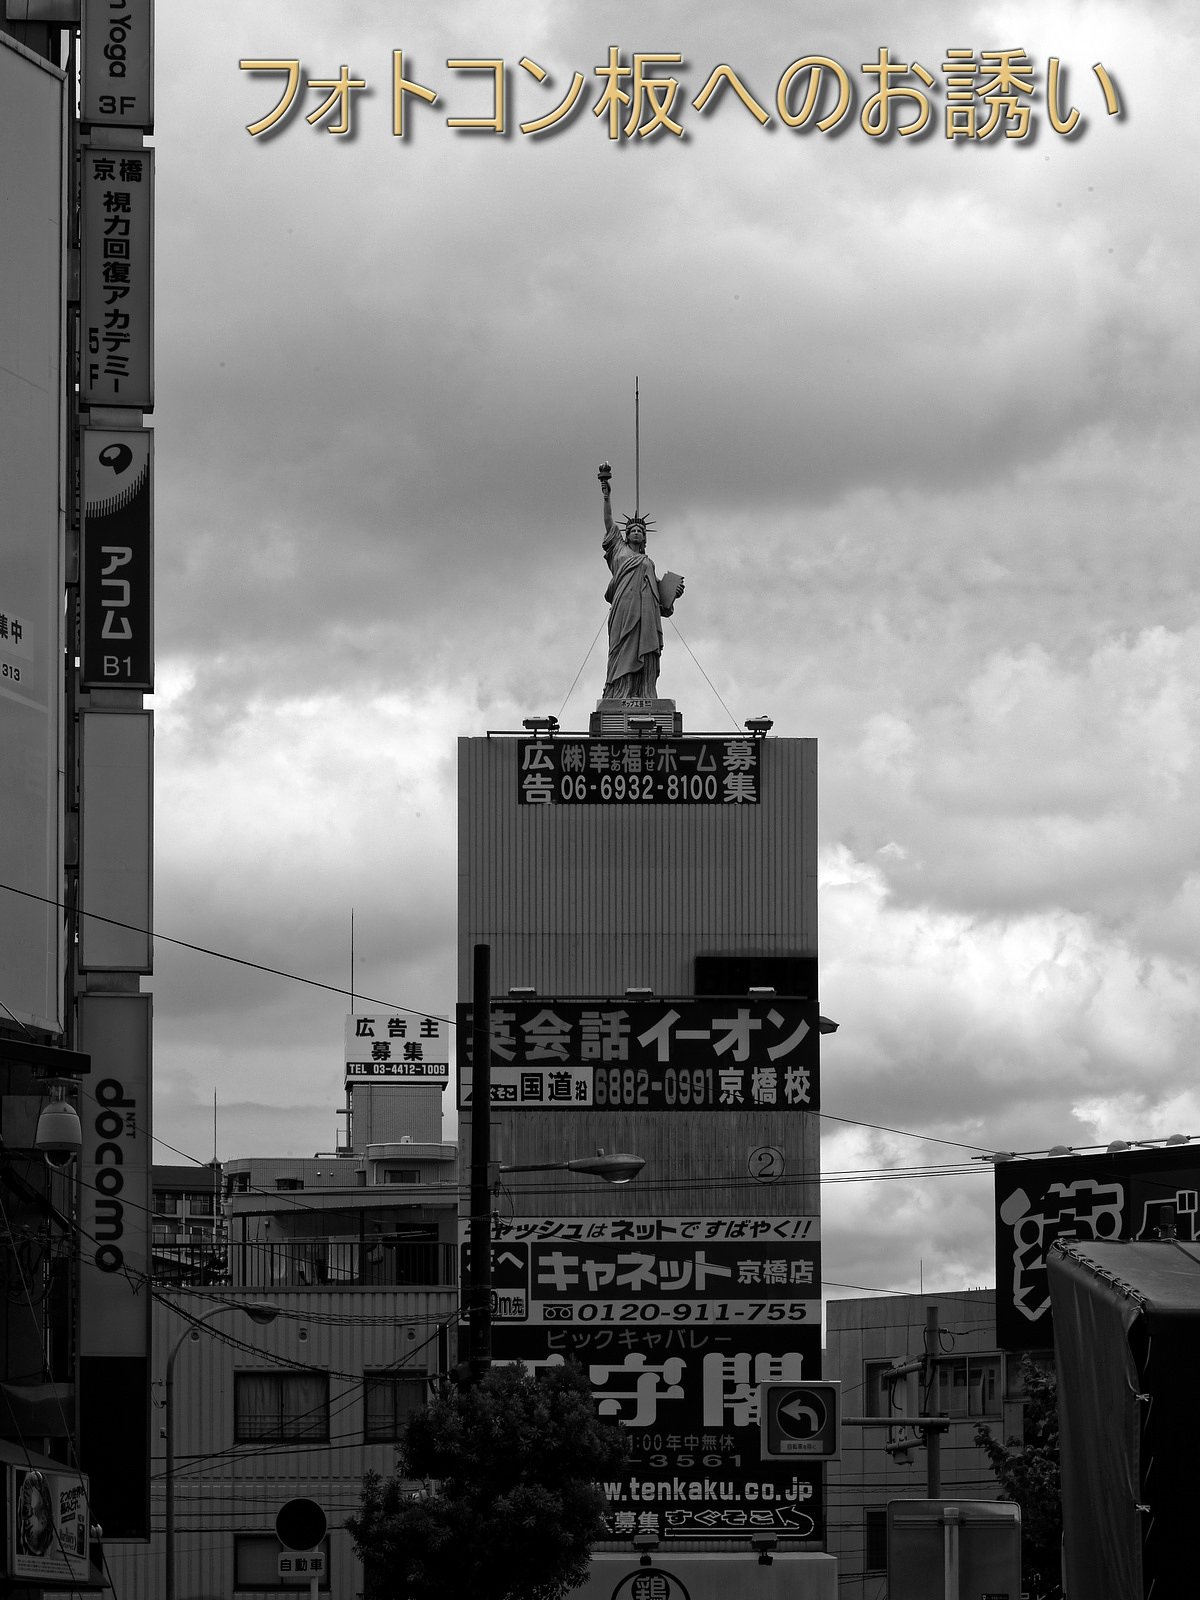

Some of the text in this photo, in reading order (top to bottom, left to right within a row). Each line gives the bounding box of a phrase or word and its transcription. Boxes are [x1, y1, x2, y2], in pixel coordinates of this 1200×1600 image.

[104, 14, 131, 78] Yoga
[99, 95, 137, 115] 3F
[92, 158, 142, 183] 京橋
[102, 190, 131, 393] 視力回復アカデミー
[101, 545, 133, 640] アコム
[103, 655, 132, 678] B1
[560, 774, 718, 800] 06-6932-8100
[355, 1017, 440, 1038] 広告主
[371, 1041, 423, 1061] 募集
[349, 1063, 446, 1075] TEL 03-4412-1009
[718, 1066, 811, 1104] 京橋校
[126, 1112, 136, 1140] NTT
[95, 1078, 136, 1273] docomo
[537, 1250, 814, 1293] キャネット 京橋店
[578, 1303, 808, 1321] 0120-911-755
[280, 1558, 323, 1572] 自動車
